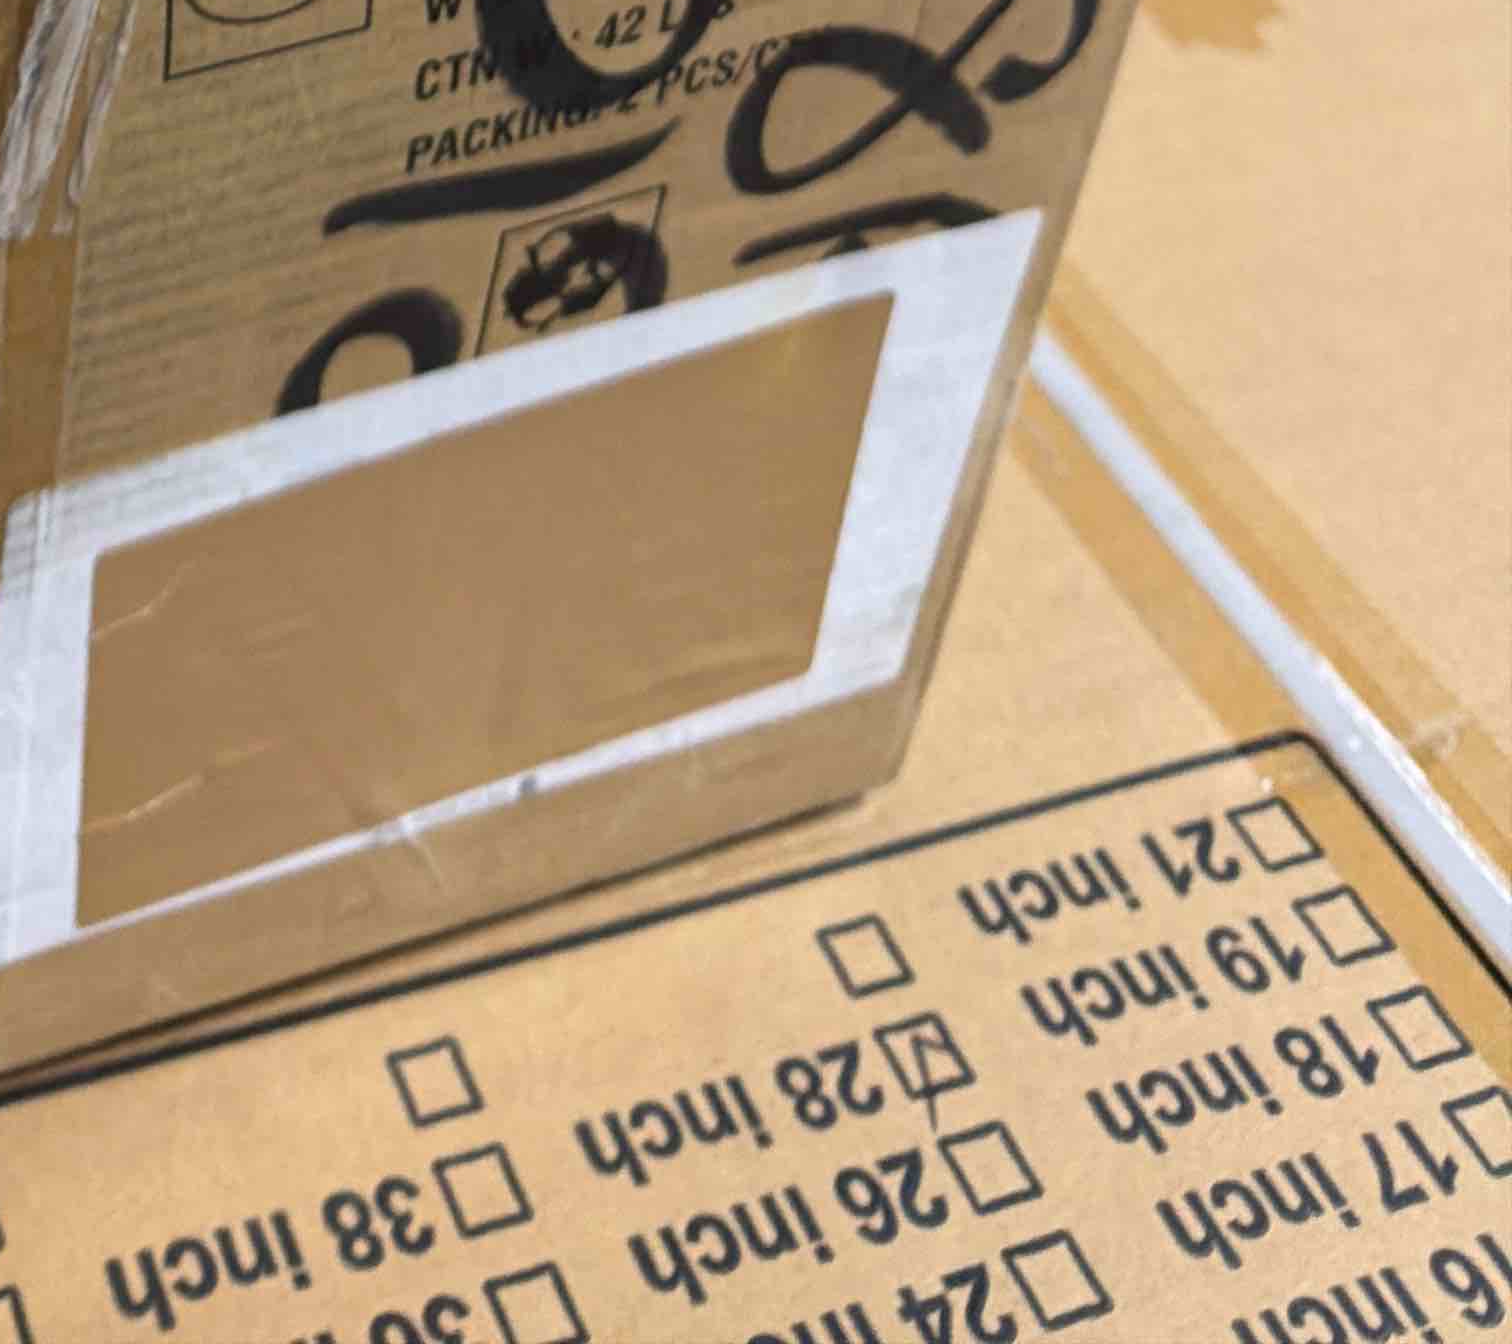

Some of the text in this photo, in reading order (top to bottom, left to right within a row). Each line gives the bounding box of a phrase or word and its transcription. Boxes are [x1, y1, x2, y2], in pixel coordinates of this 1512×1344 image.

[414, 47, 498, 103] CTN
[593, 5, 647, 50] 42
[957, 818, 1241, 945] 21 inch
[1020, 915, 1307, 1047] 19 inch
[572, 1039, 886, 1188] 28 inch
[1085, 1014, 1380, 1155] 18 inch
[104, 1173, 436, 1333] 38 inch
[626, 1147, 950, 1308] 26 inch
[1154, 1119, 1461, 1270] 17 inch
